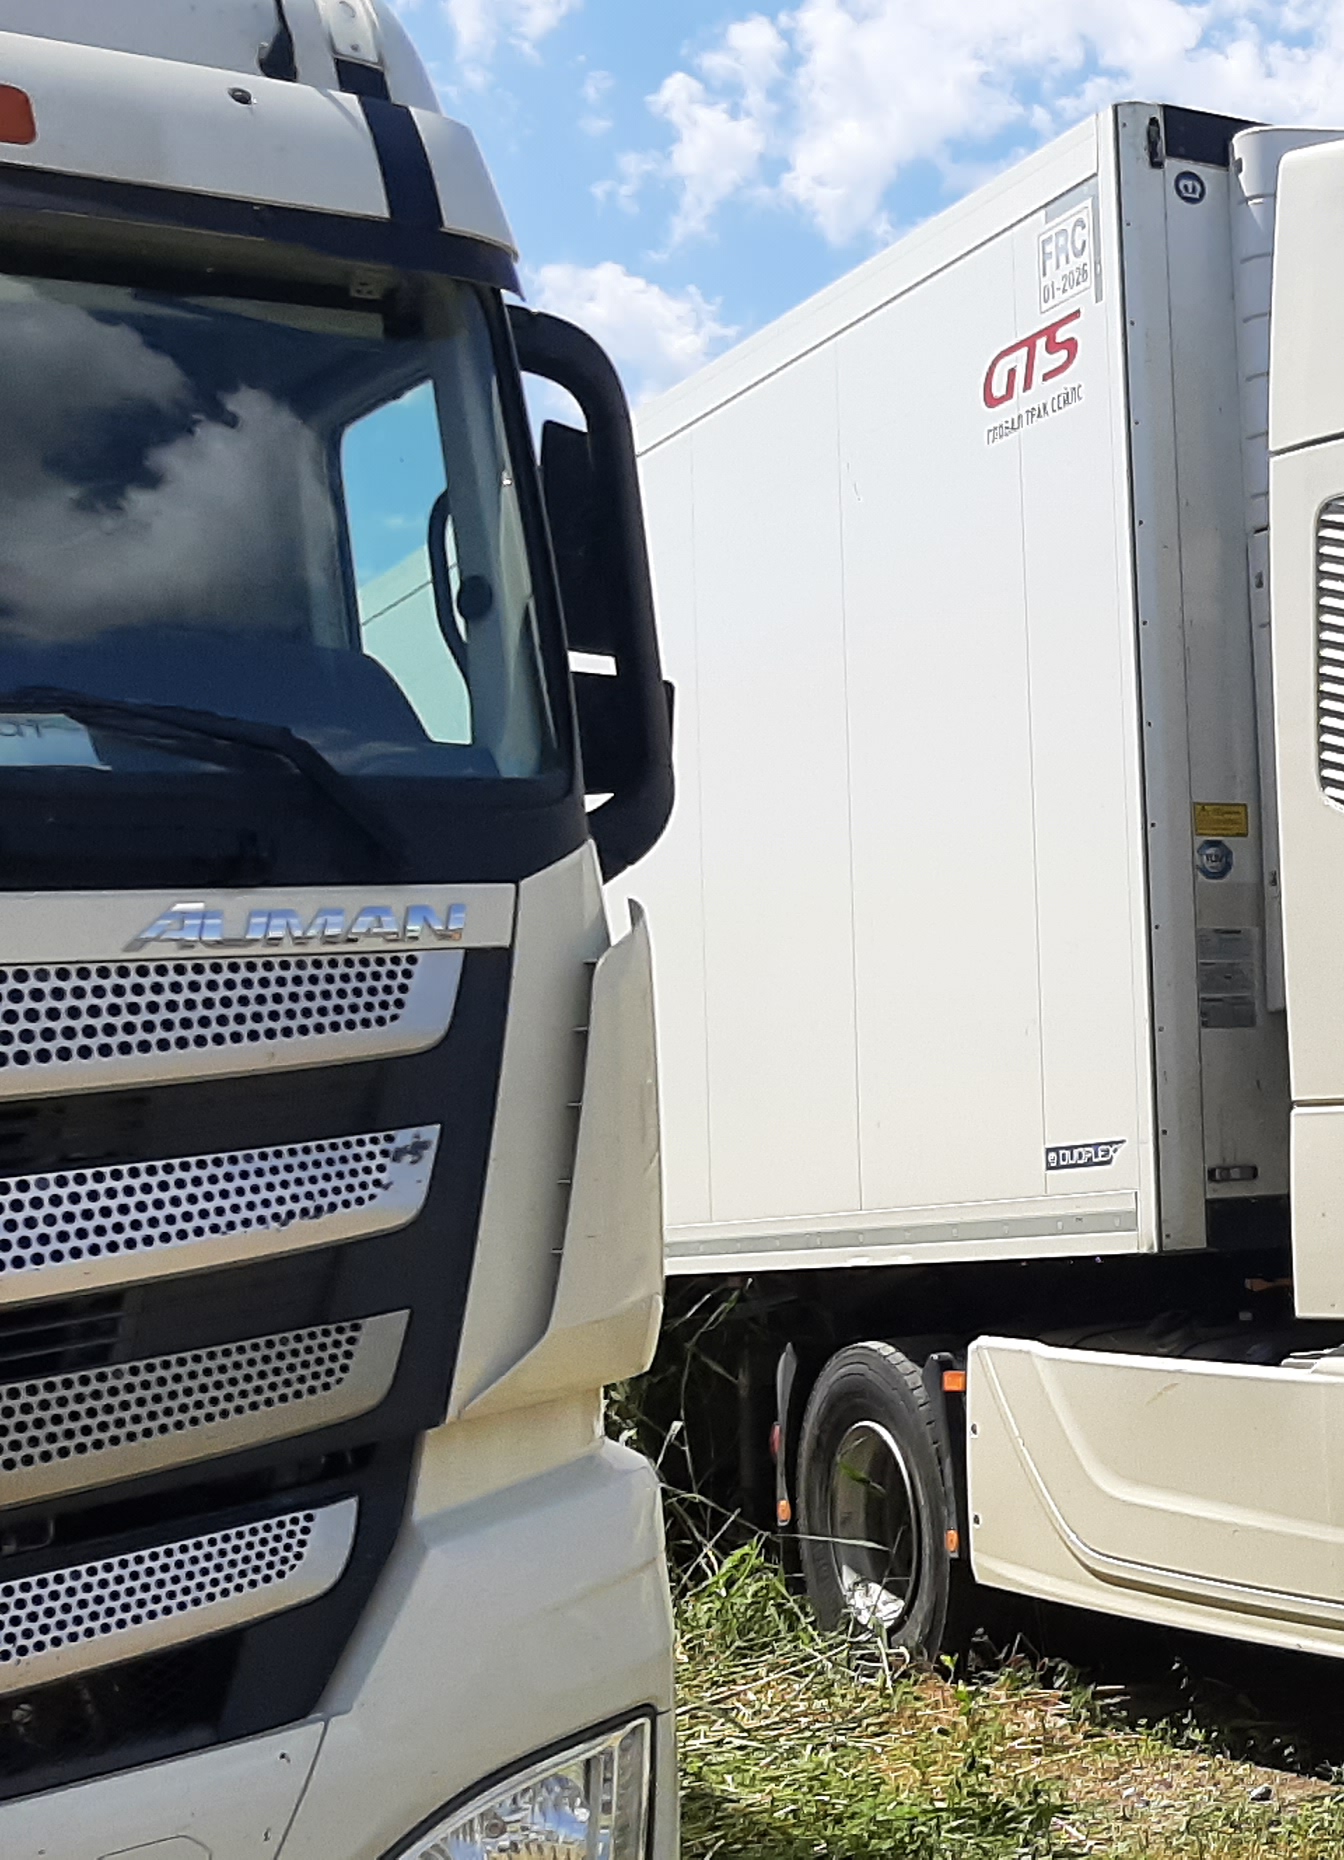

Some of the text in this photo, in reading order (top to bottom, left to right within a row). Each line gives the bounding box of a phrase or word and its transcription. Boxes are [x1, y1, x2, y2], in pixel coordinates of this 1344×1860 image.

[1041, 217, 1087, 277] FRC
[1043, 262, 1089, 304] 01-2026
[983, 308, 1081, 409] GTS
[121, 902, 467, 952] AUMAN
